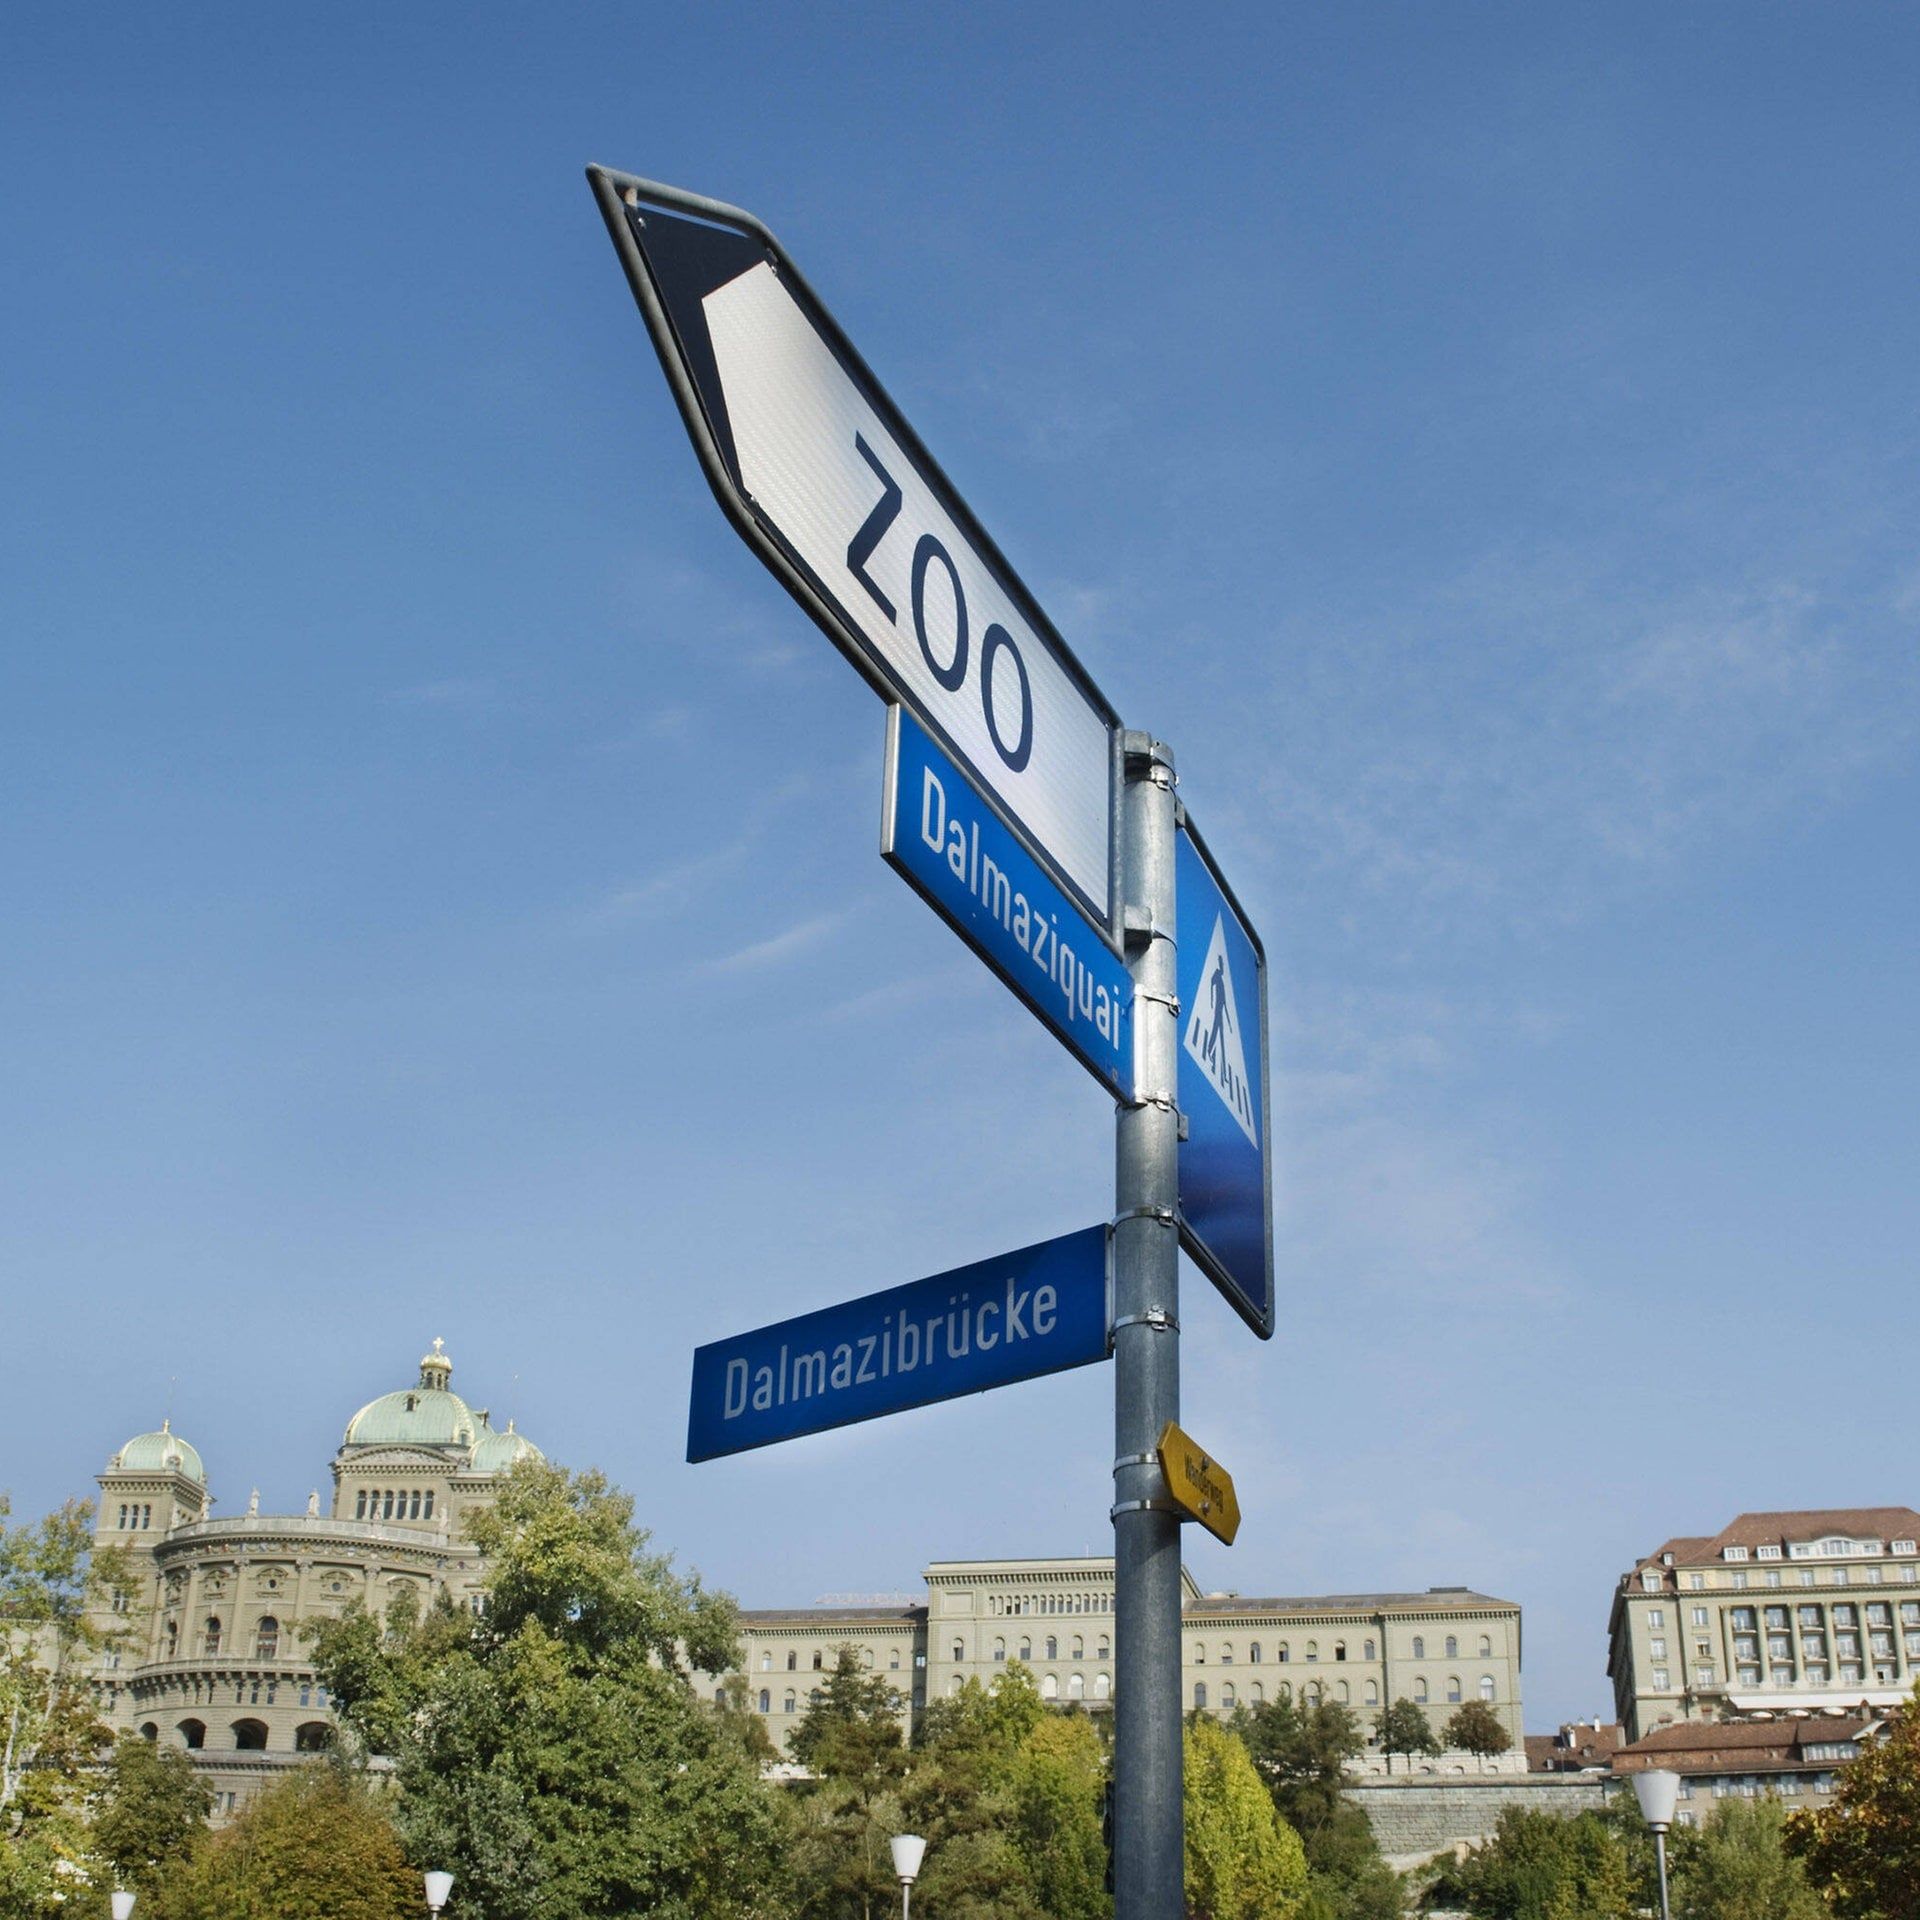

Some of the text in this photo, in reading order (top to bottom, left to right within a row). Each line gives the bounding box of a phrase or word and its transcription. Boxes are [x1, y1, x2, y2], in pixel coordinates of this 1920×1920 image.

[847, 431, 1033, 773] ZOO
[921, 765, 1120, 1051] Dalmaziquai
[723, 1277, 1058, 1420] Dalmazibrücke
